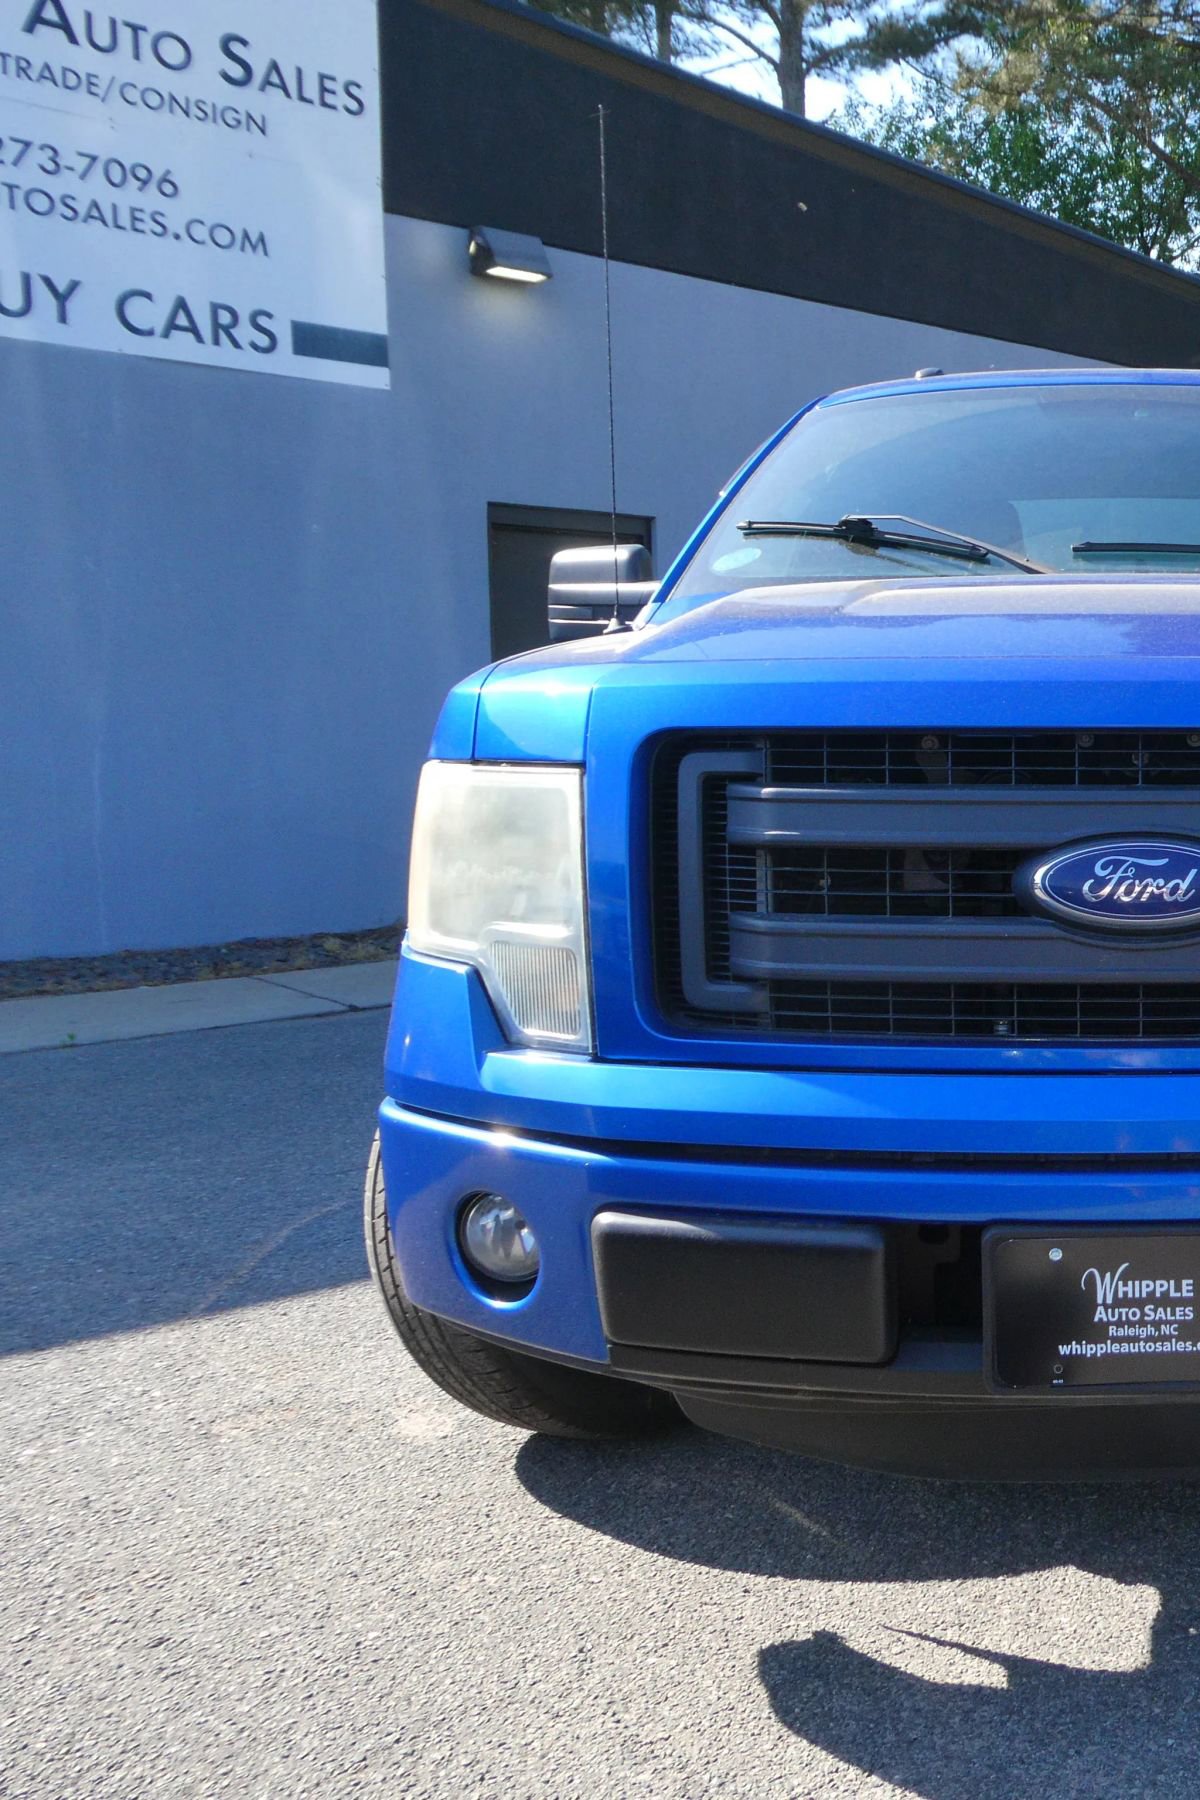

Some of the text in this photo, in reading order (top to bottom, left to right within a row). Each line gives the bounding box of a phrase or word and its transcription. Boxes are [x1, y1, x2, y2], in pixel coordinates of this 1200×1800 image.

[21, 0, 365, 117] AUTO SALES
[0, 52, 268, 137] TRADE/CONSIGN
[0, 136, 180, 199] 73-7096
[115, 288, 279, 355] CARS
[1082, 855, 1198, 903] Ford
[1081, 1262, 1194, 1304] WHIPPLE
[1094, 1305, 1194, 1322] AUTO SALES
[1108, 1324, 1179, 1338] Raleigh, NC
